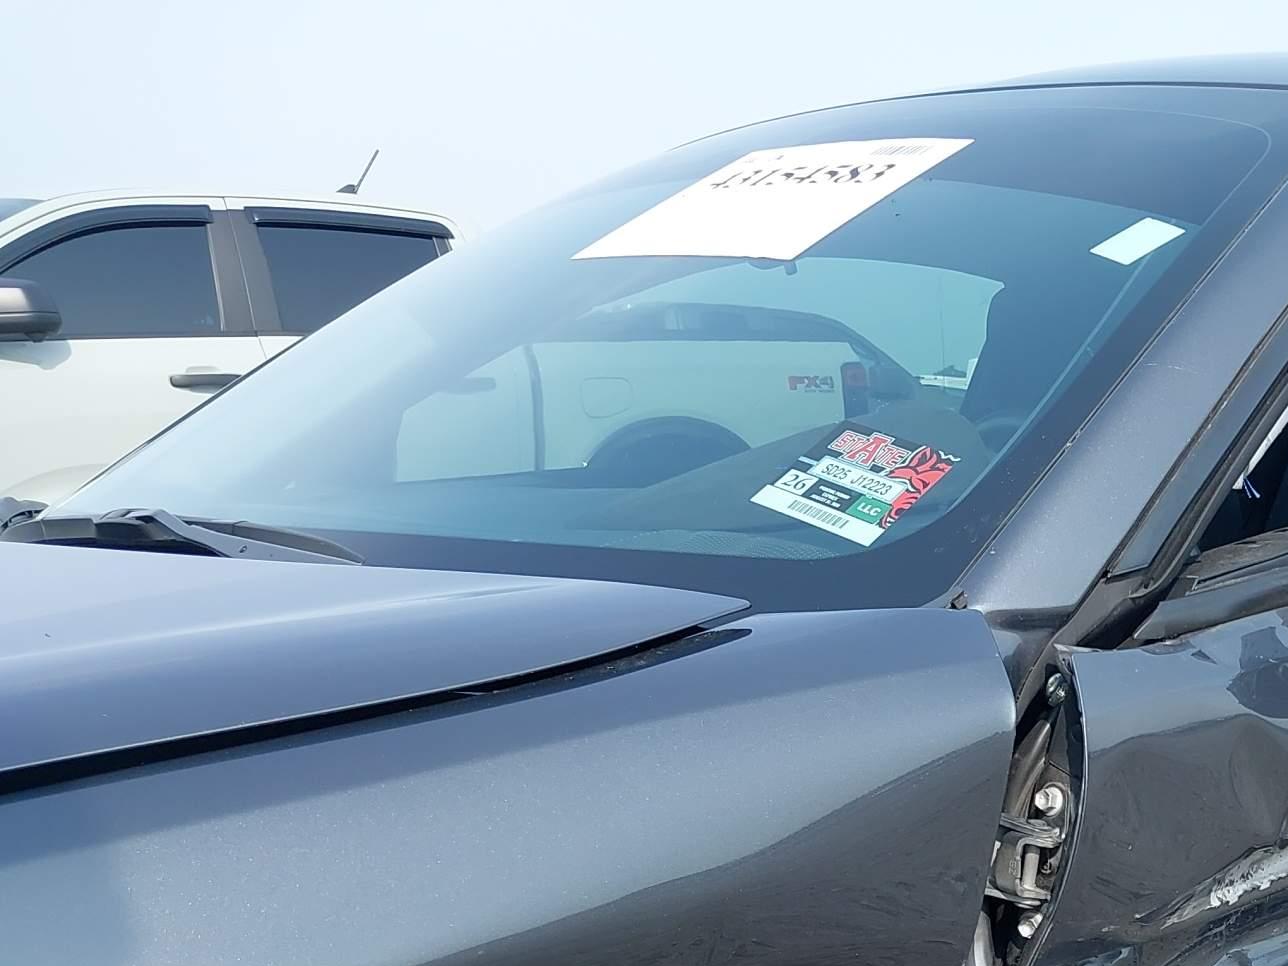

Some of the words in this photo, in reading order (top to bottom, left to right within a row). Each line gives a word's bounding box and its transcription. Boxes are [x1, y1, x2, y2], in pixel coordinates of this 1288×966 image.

[828, 429, 912, 471] STATE
[781, 472, 808, 491] 26
[821, 462, 850, 481] SD25
[850, 473, 893, 496] J12223
[856, 502, 882, 517] LLC
